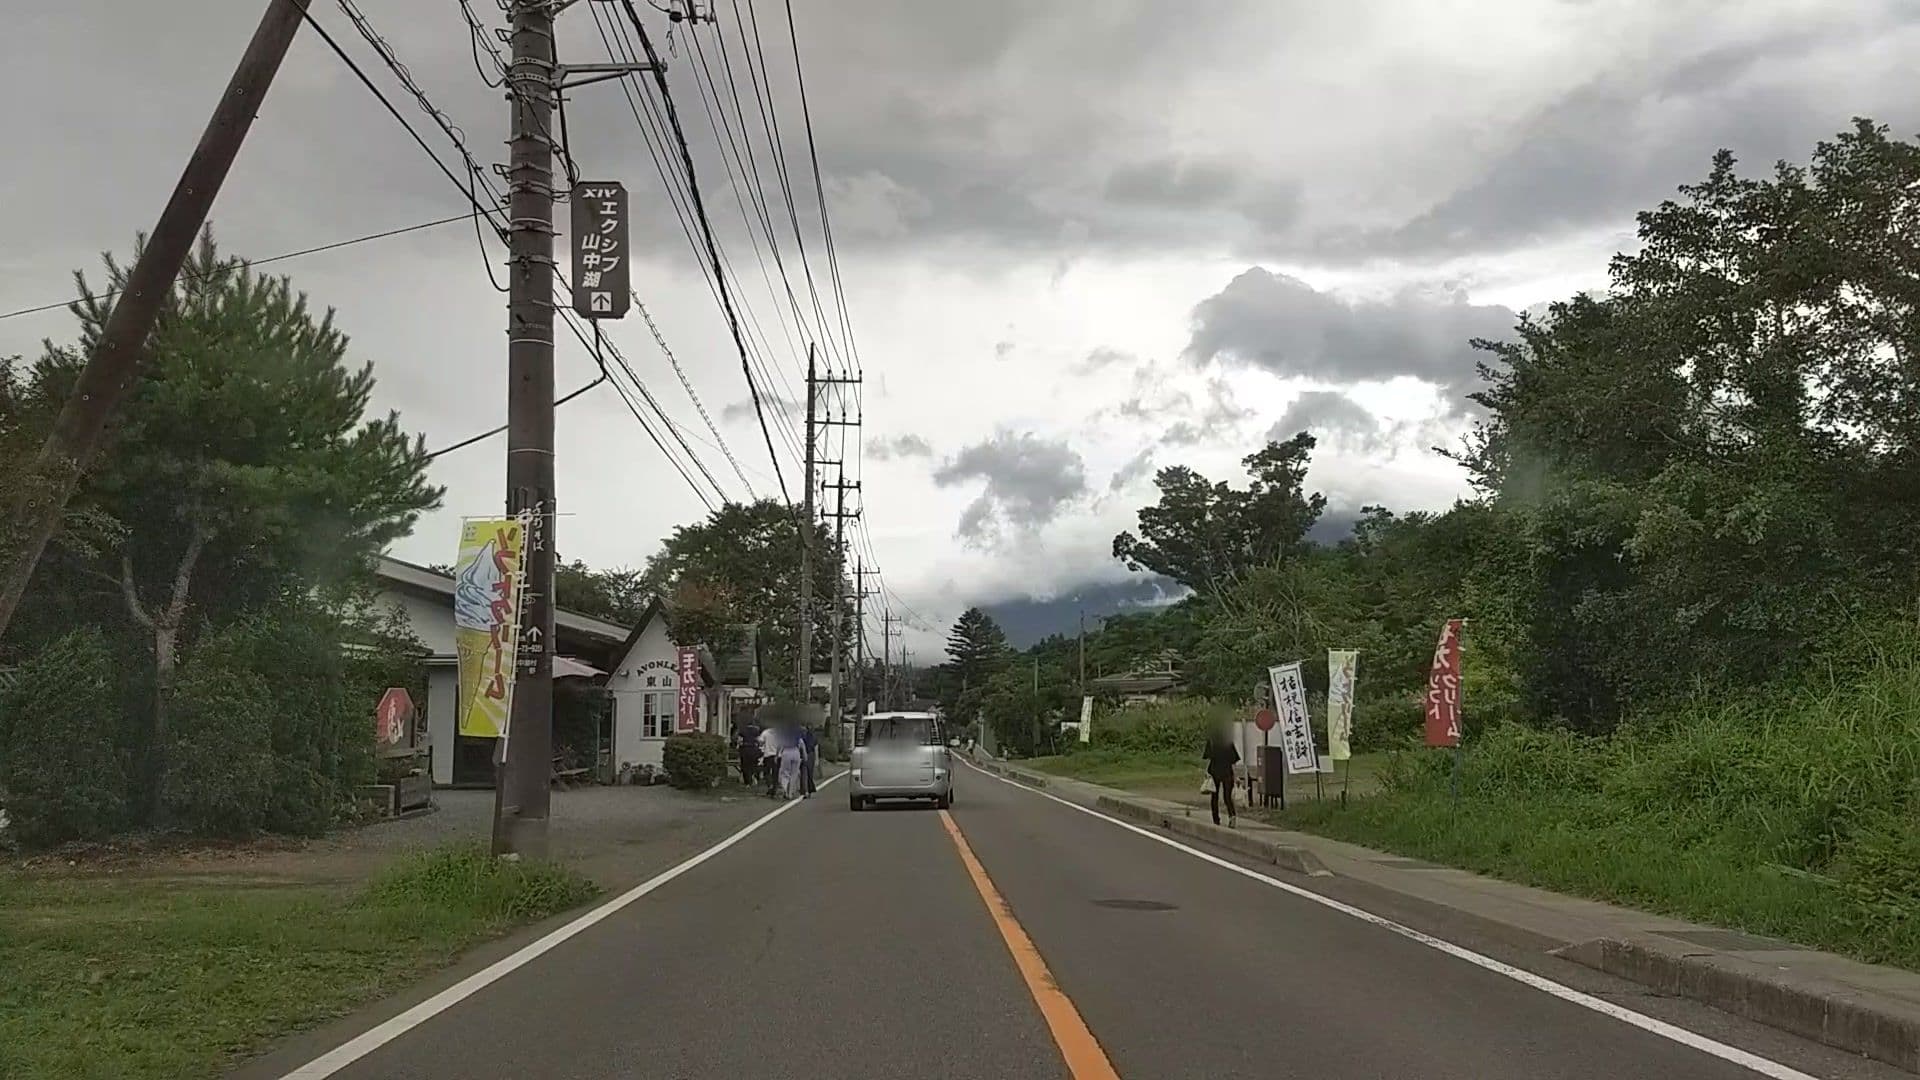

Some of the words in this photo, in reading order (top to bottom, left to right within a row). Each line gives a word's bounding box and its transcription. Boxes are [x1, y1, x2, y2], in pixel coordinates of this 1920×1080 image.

[582, 188, 618, 198] XIV
[581, 233, 602, 289] 山中湖
[600, 201, 621, 273] エクシブ
[636, 660, 680, 677] AVONLE
[1279, 675, 1308, 760] 桔梗信玄餅
